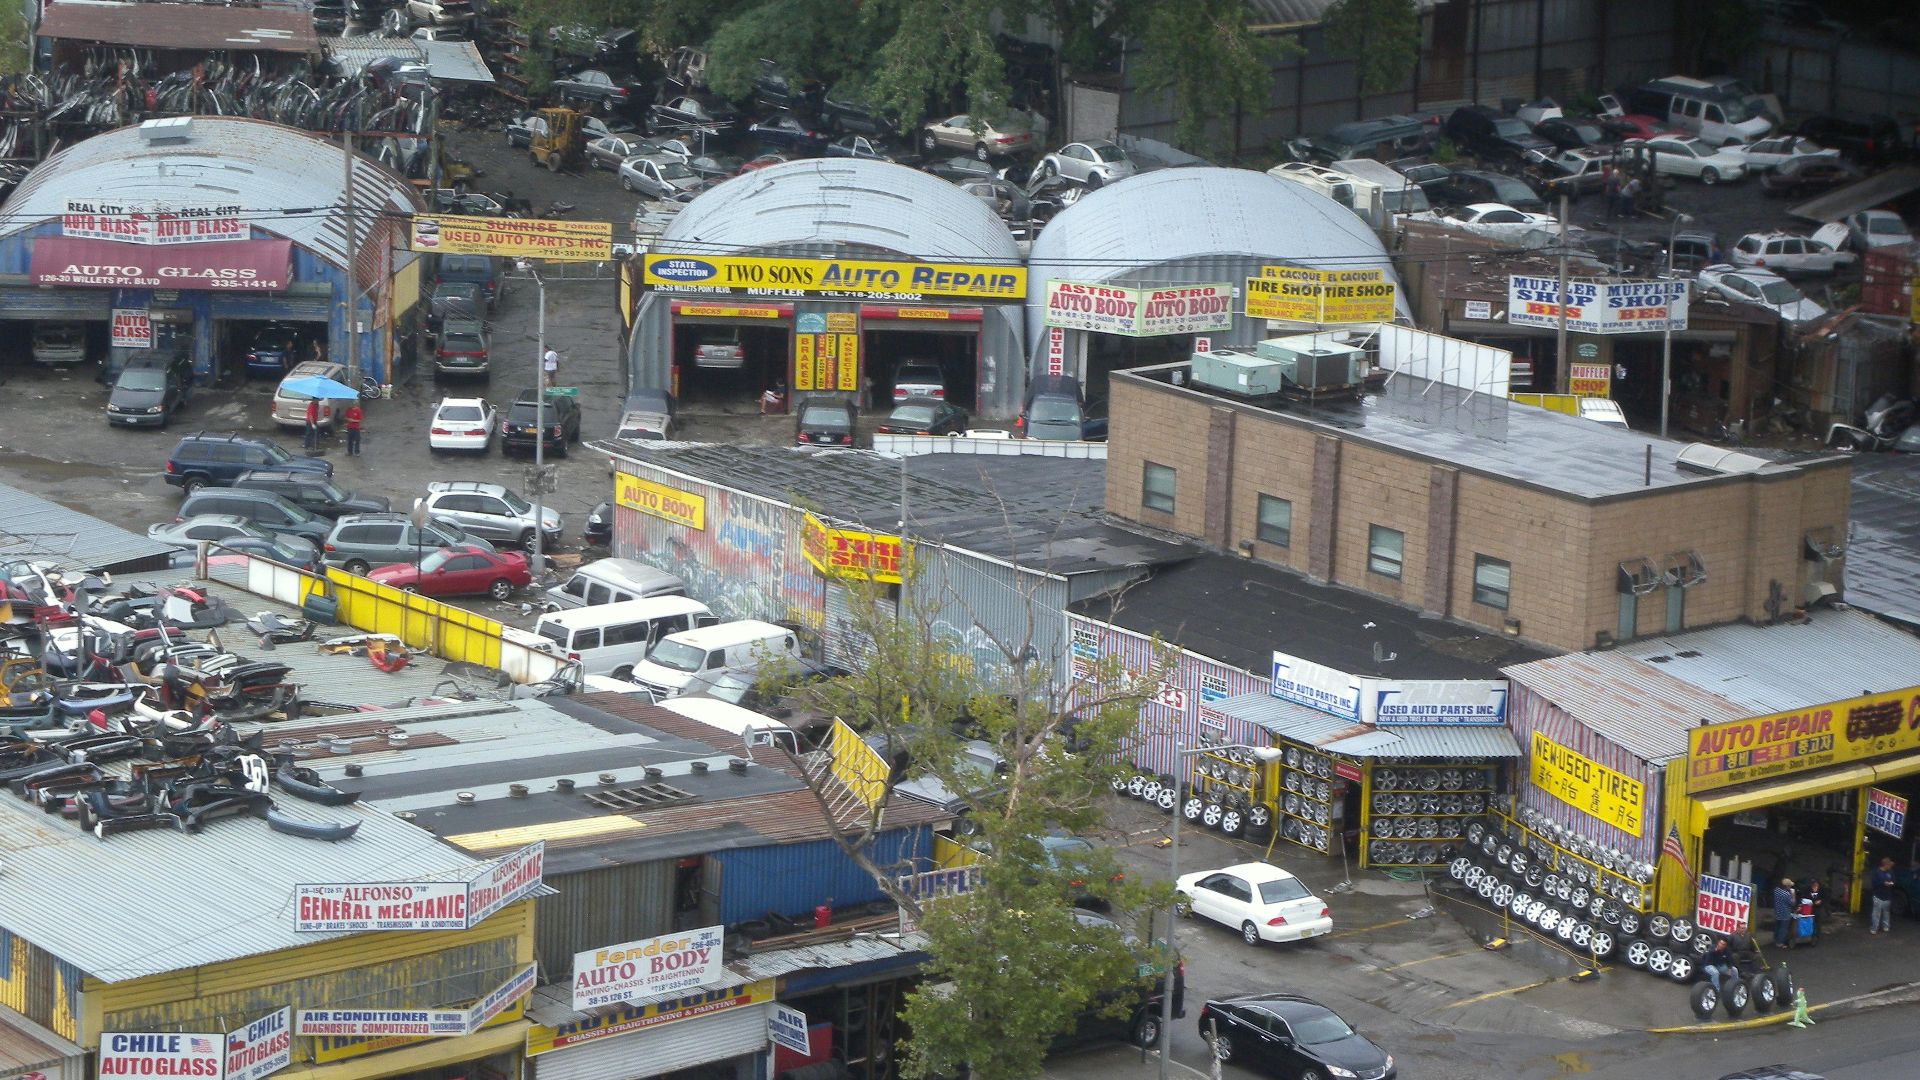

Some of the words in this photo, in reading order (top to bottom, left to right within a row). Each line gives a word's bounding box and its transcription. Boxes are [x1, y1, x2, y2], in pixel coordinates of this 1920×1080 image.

[68, 203, 96, 213] REAL
[100, 205, 123, 215] CITY
[181, 205, 211, 217] REAL
[215, 203, 241, 215] CITY
[64, 213, 95, 230] AUTO
[100, 216, 139, 235] GLASS
[157, 220, 191, 237] AUTO
[197, 217, 239, 234] GLASS
[486, 220, 558, 233] SUNRISE
[565, 223, 608, 231] FOREIGN
[444, 230, 481, 243] USED
[486, 233, 524, 245] AUTO
[528, 235, 575, 248] PARTS
[579, 238, 609, 249] INC.
[62, 264, 142, 277] AUTO
[158, 266, 257, 279] GLASS
[657, 268, 709, 277] INSPECTION
[669, 261, 697, 269] STATE
[73, 275, 114, 285] WILLETS
[117, 276, 132, 285] PT.
[134, 277, 160, 286] BLVD
[725, 264, 764, 283] TWO
[768, 265, 813, 285] SONS
[820, 263, 900, 289] AUTO
[911, 266, 1017, 294] REPAIR
[1266, 268, 1277, 278] EL
[1327, 273, 1337, 282] EL
[1340, 271, 1379, 282] CACIQUE
[211, 279, 278, 288] 335-1414
[674, 285, 698, 293] WILLETS
[698, 286, 714, 294] POINT
[1060, 283, 1126, 299] ASTRO
[1248, 280, 1278, 294] TIRE
[1281, 283, 1322, 297] SHOP
[1325, 285, 1354, 298] TIRE
[1355, 284, 1394, 297] SHOP
[1607, 282, 1685, 297] MUFFLER
[747, 287, 805, 297] MUFFLER
[1152, 287, 1216, 300] ASTRO
[1517, 289, 1594, 306] SHOP
[1050, 292, 1092, 313] AUTO
[1095, 299, 1138, 319] BODY
[1144, 299, 1186, 319] AUTO
[1189, 295, 1230, 316] BODY
[1608, 294, 1680, 308] SHOP
[690, 307, 721, 315] SHOCKS
[738, 309, 769, 317] BRAKES
[901, 309, 948, 318] INSPECTION
[1095, 315, 1116, 323] CHASSIS
[1188, 315, 1209, 323] CHASSIS
[1511, 313, 1544, 322] REPAIR
[115, 315, 147, 327] AUTO
[112, 326, 150, 338] GLASS
[1051, 327, 1062, 355] AUTO
[801, 337, 809, 387] BRAKES
[1572, 366, 1609, 379] MUFFLER
[1573, 379, 1606, 392] SHOP
[624, 485, 657, 509] AUTO
[662, 496, 697, 522] BODY
[1202, 675, 1227, 688] TIRE
[1202, 681, 1227, 693] SHOP
[1278, 677, 1295, 691] USED
[1296, 683, 1314, 697] AUTO
[1315, 690, 1338, 705] PARTS
[1202, 709, 1224, 721] SHOCKS
[1382, 705, 1408, 715] USED
[1411, 705, 1438, 715] AUTO
[1440, 705, 1474, 715] PARTS
[1476, 705, 1496, 715] INC.
[1695, 724, 1755, 756] AUTO
[1758, 708, 1833, 744] REPAIR
[1870, 789, 1906, 813] MUFFLER
[1869, 801, 1903, 825] AUTO
[1866, 812, 1902, 837] REPAIR
[491, 855, 522, 884] ALFONSO
[470, 885, 500, 916] GENERAL
[501, 852, 542, 897] MECHANIC
[1701, 876, 1750, 903] MUFFLER
[343, 886, 413, 901] ALFONSO
[300, 895, 372, 921] GENERAL
[378, 894, 465, 920] MECHANIC
[1698, 893, 1748, 919] BODY
[300, 922, 323, 930] TUNE-UP
[349, 921, 368, 929] SHOCKS
[377, 921, 413, 929] TRANSMISSION
[420, 920, 429, 929] AIR
[431, 920, 464, 929] CONDITIONER
[1698, 910, 1746, 933] WOR
[595, 938, 692, 967] Fender
[575, 961, 636, 990] AUTO
[650, 947, 712, 975] BODY
[646, 966, 705, 985] STRAIGHTENING
[485, 994, 496, 1010] AIR
[495, 965, 535, 1001] CONDITIONER
[588, 994, 608, 1005] 38-15
[609, 991, 623, 1002] 126
[304, 1011, 329, 1021] AIR
[332, 1011, 428, 1022] CONDITIONER
[566, 1026, 606, 1043] CHASSIS
[684, 1009, 692, 1017] &
[693, 998, 737, 1014] PAINTING
[777, 1009, 804, 1029] AIR
[248, 1010, 284, 1043] CHILE
[302, 1023, 357, 1034] DIAGNOSTIC
[361, 1023, 430, 1034] COMPUTERIZED
[112, 1034, 180, 1053] CHILE
